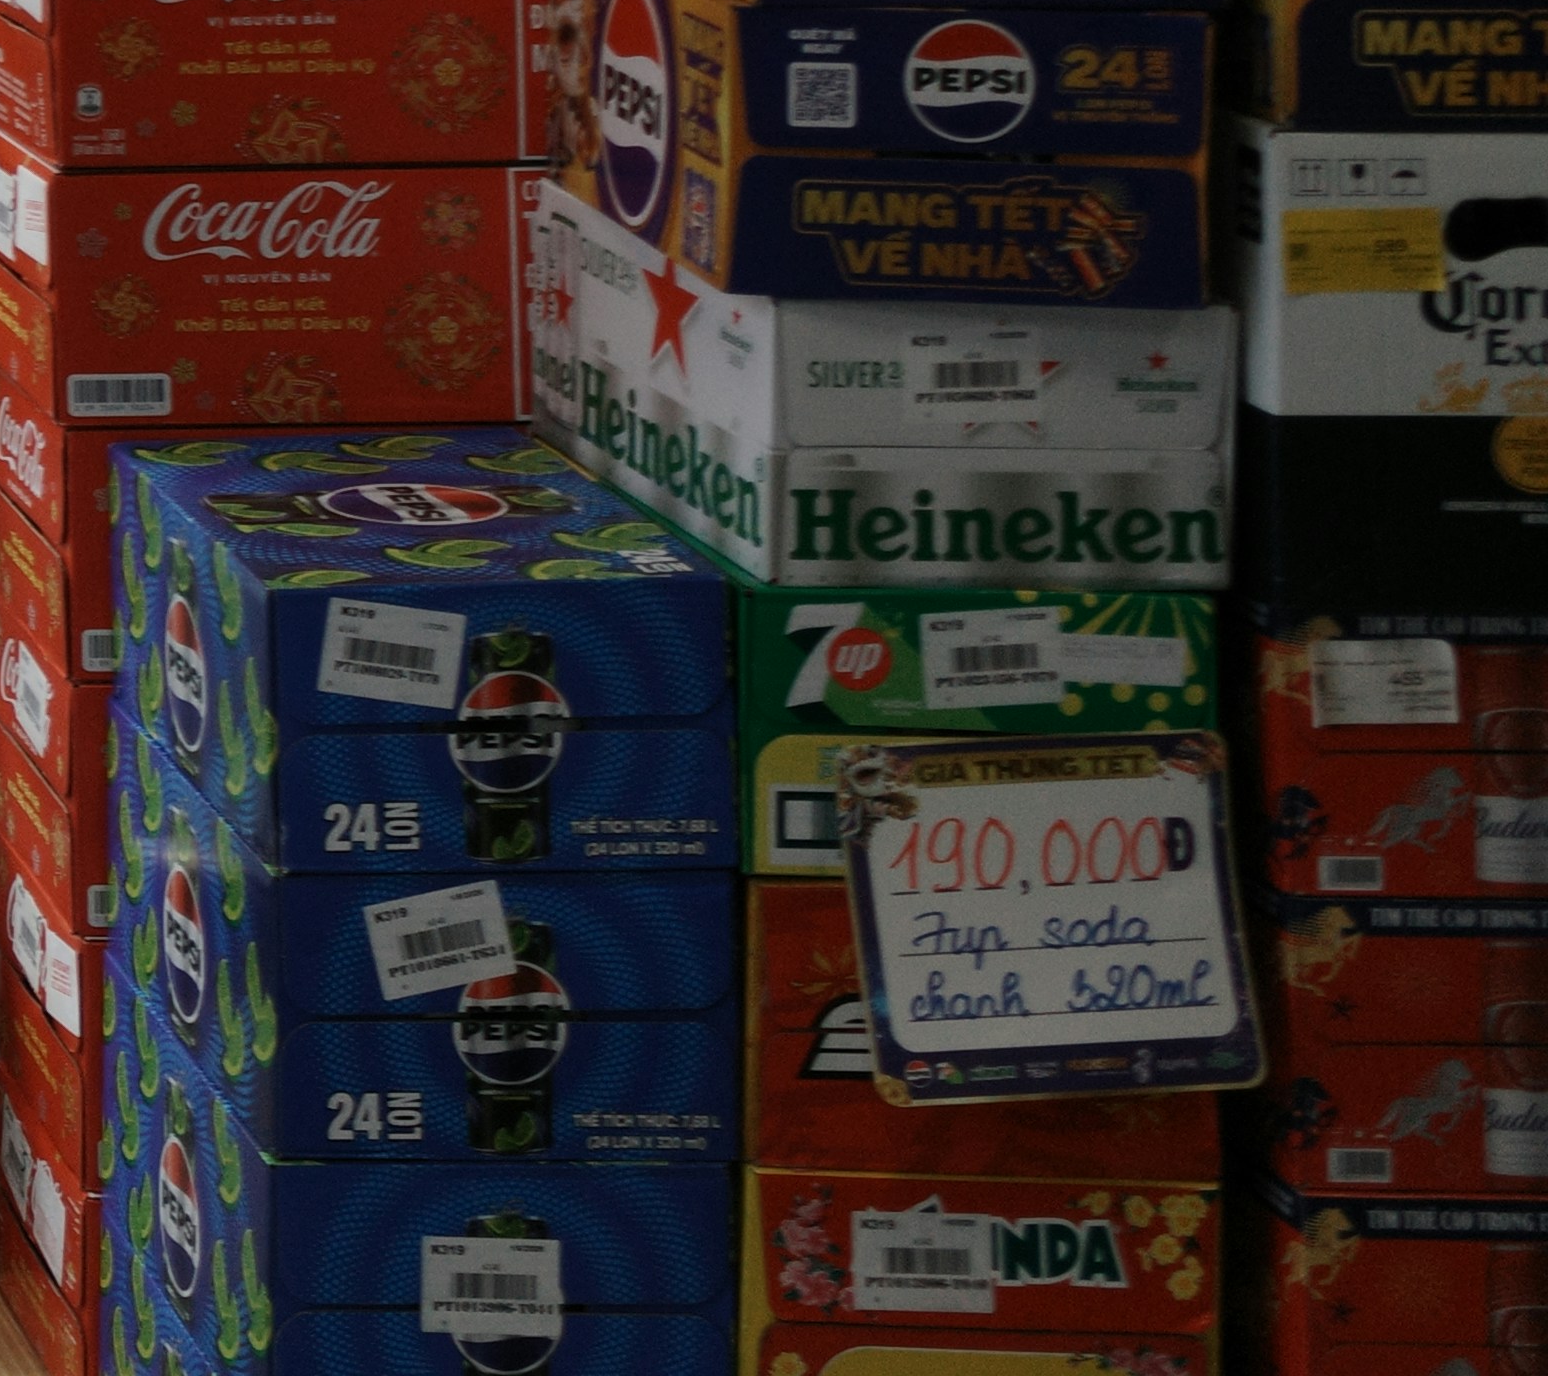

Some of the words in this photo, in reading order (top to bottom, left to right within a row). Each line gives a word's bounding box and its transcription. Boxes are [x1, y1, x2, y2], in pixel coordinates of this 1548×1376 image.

[914, 67, 1027, 94] PEPSI
[143, 180, 394, 261] Coca-Cola
[802, 189, 952, 228] MANG
[841, 232, 907, 276] VỀ
[808, 360, 884, 389] SILVER
[579, 362, 763, 546] Heineken
[790, 489, 1226, 563] Heineken
[341, 606, 376, 621] K319
[915, 761, 968, 783] GIÁ
[972, 755, 1078, 781] THÙNG
[1090, 747, 1148, 775] TẾT
[325, 803, 379, 851] 24
[385, 803, 420, 850] LON
[1040, 905, 1152, 947] soda
[910, 972, 1028, 1020] chanh
[458, 1005, 554, 1042] PEPSI
